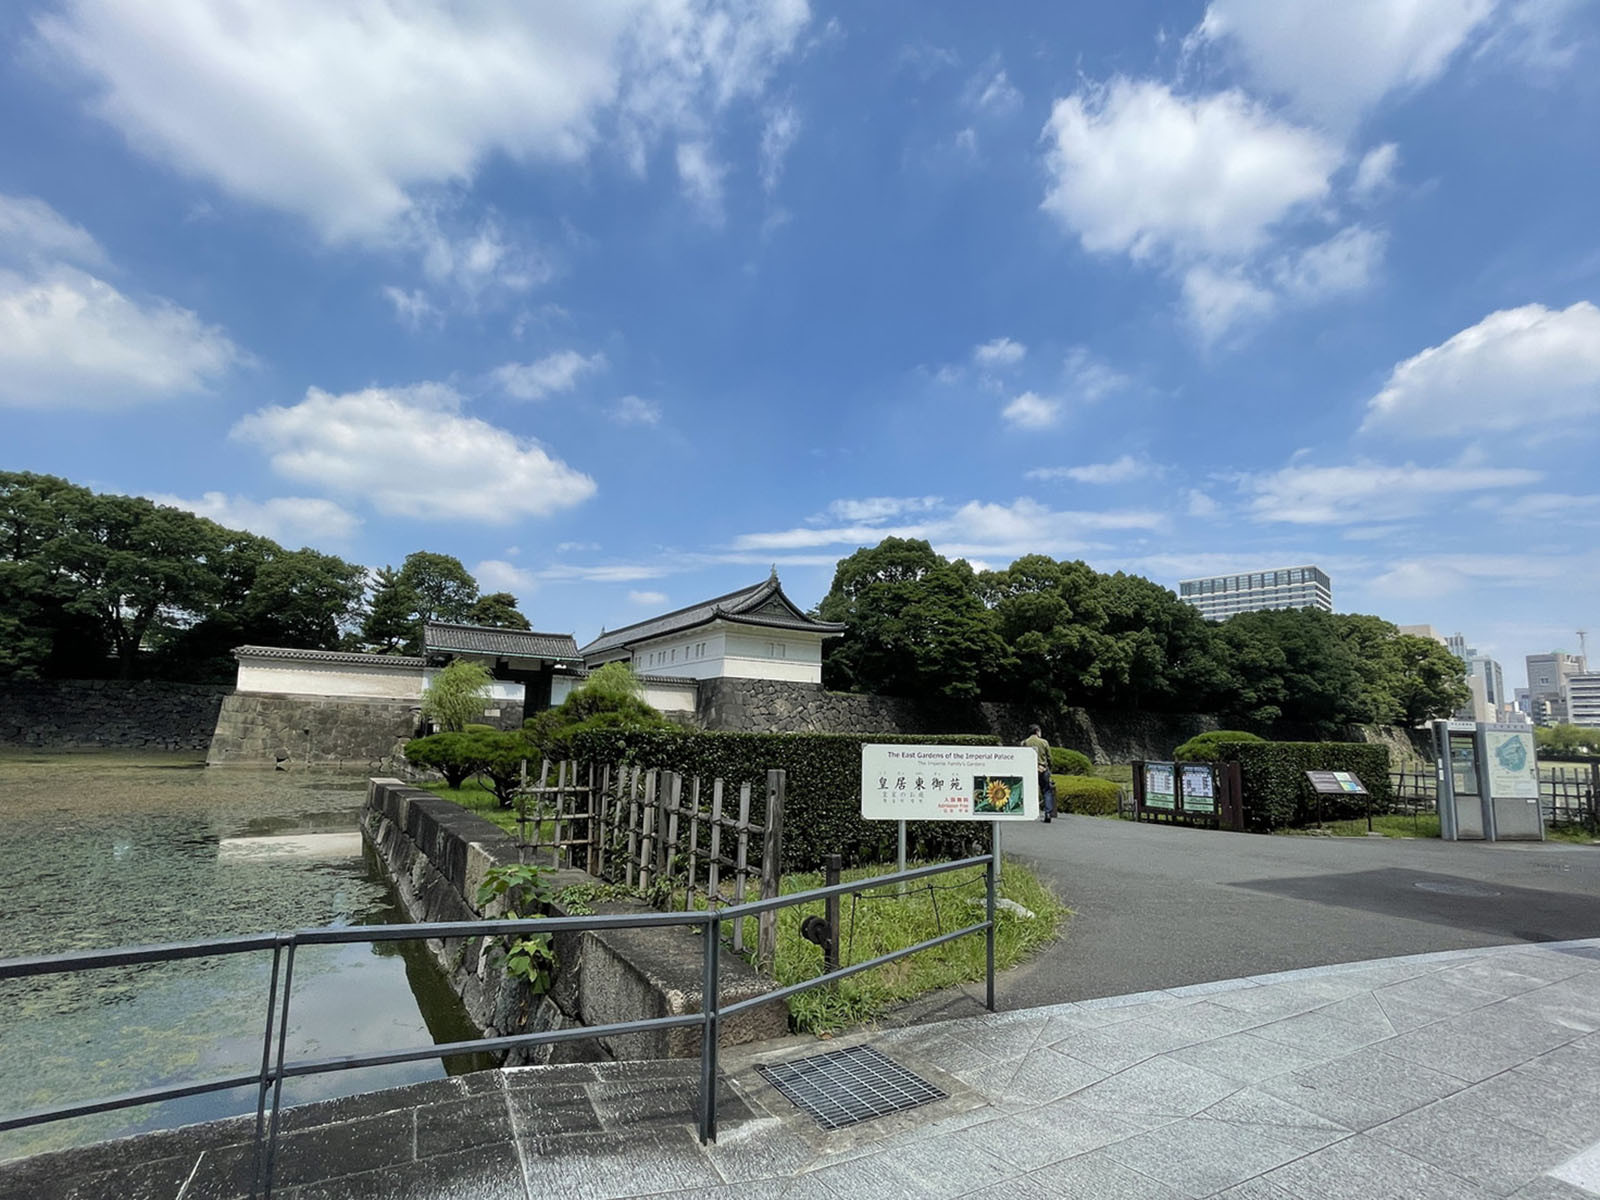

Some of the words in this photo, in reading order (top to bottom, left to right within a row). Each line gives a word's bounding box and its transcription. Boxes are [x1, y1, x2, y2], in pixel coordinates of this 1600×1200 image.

[965, 753, 992, 761] Imperial
[877, 776, 963, 791] 皇居東御苑
